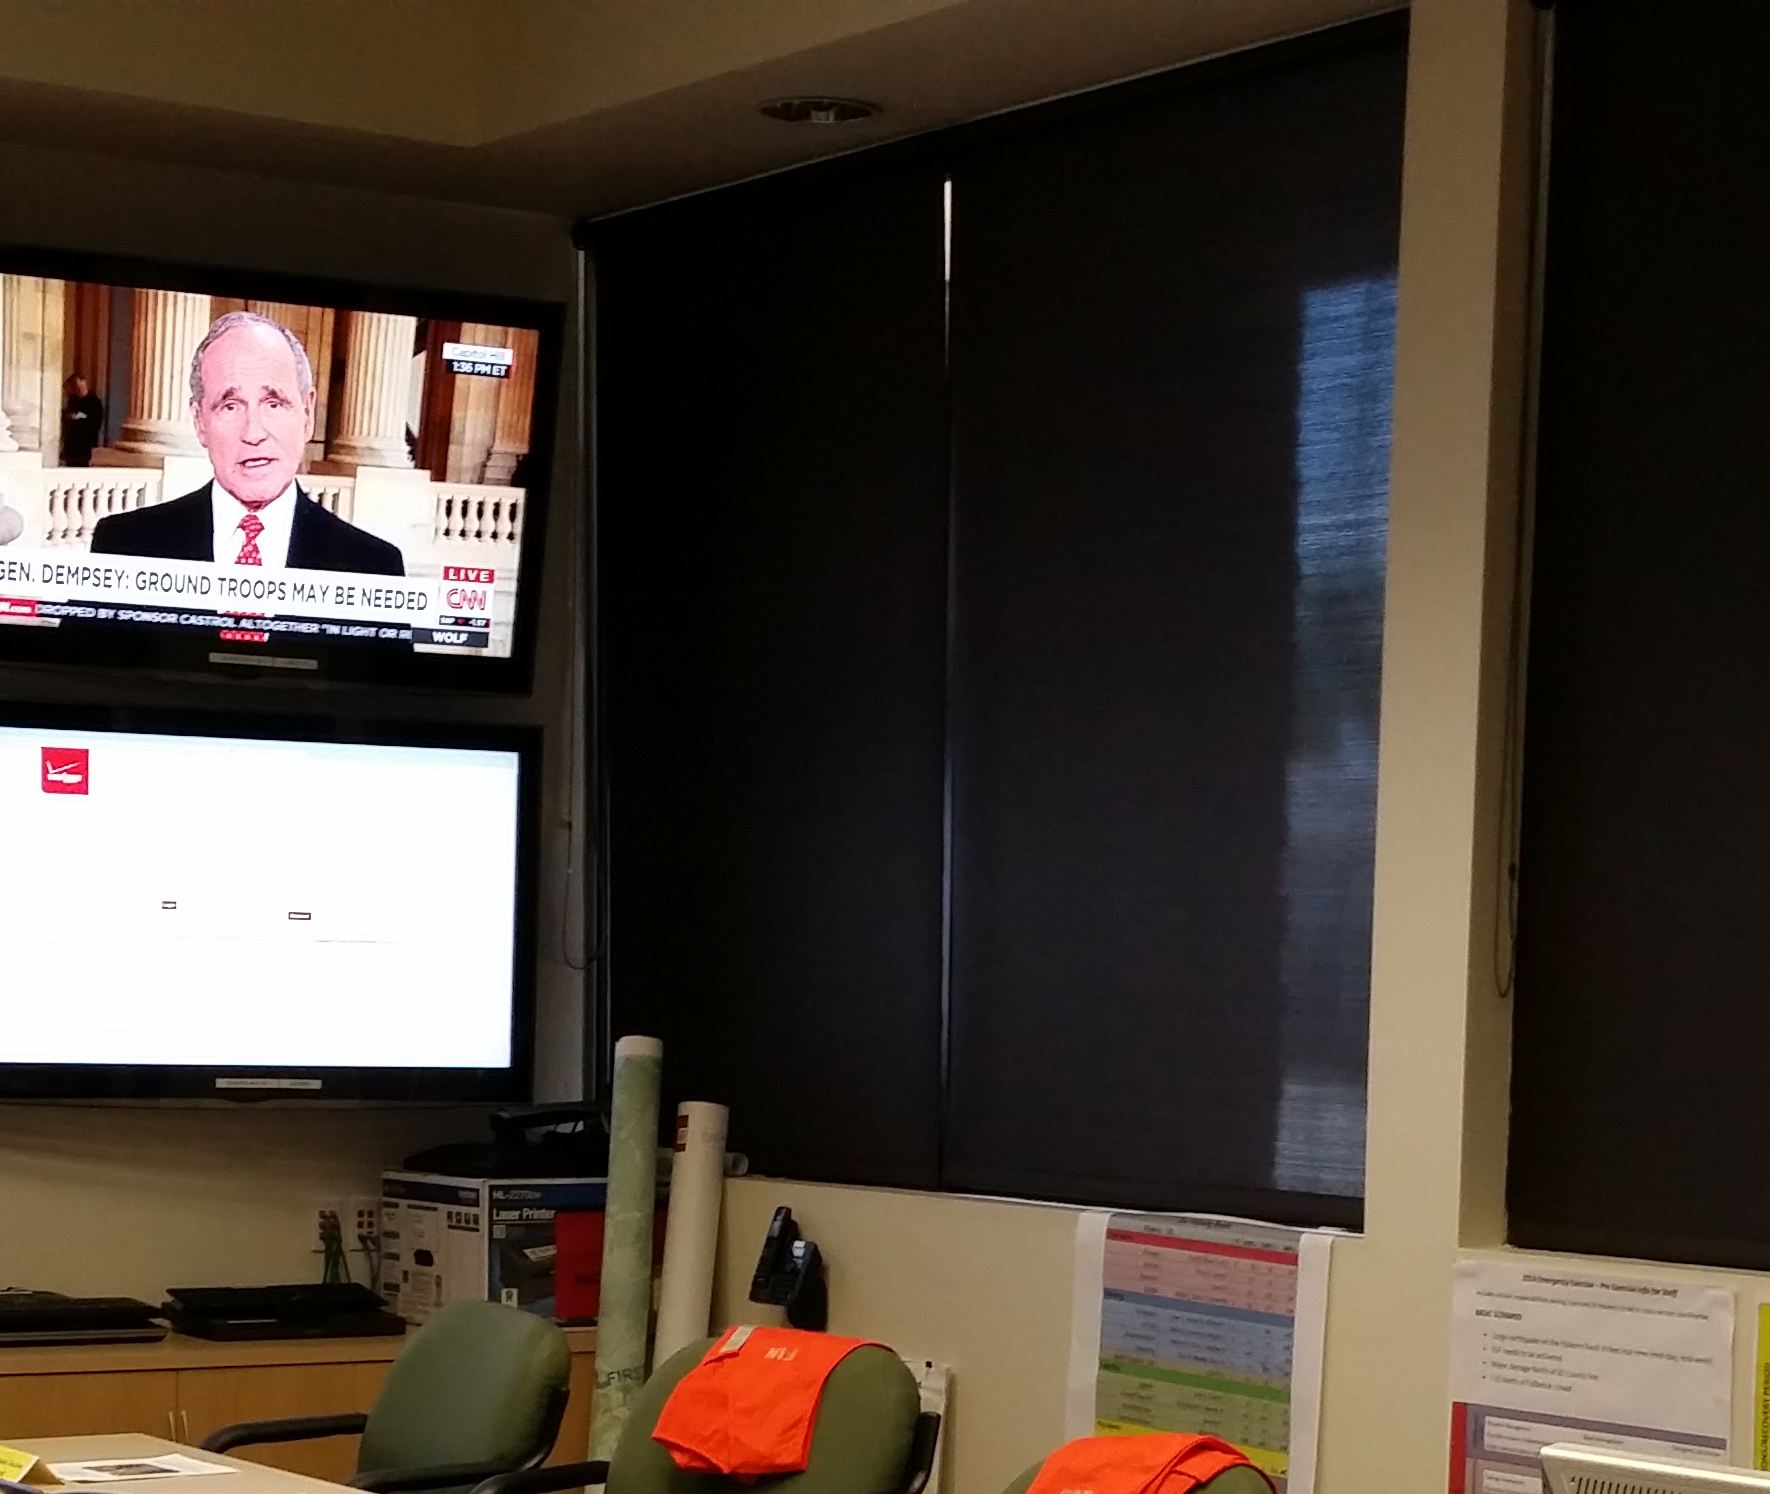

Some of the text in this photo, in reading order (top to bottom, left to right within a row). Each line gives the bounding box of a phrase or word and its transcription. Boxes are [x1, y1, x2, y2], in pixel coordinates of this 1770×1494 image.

[447, 568, 491, 582] LIVE
[42, 564, 130, 590] DEMPSEY:
[135, 571, 211, 595] GROUND
[217, 577, 286, 601] TROOPS
[291, 584, 330, 603] MAY
[334, 586, 356, 606] BE
[361, 588, 428, 611] NEEDED
[446, 588, 487, 611] CNN
[97, 607, 117, 620] BY
[117, 609, 178, 625] SPONSOR
[179, 612, 237, 628] CASTROL
[238, 617, 320, 635] ALTOGETHER
[340, 625, 377, 639] LIGHT
[432, 631, 469, 644] WOLF
[492, 1207, 557, 1221] Laser Printer
